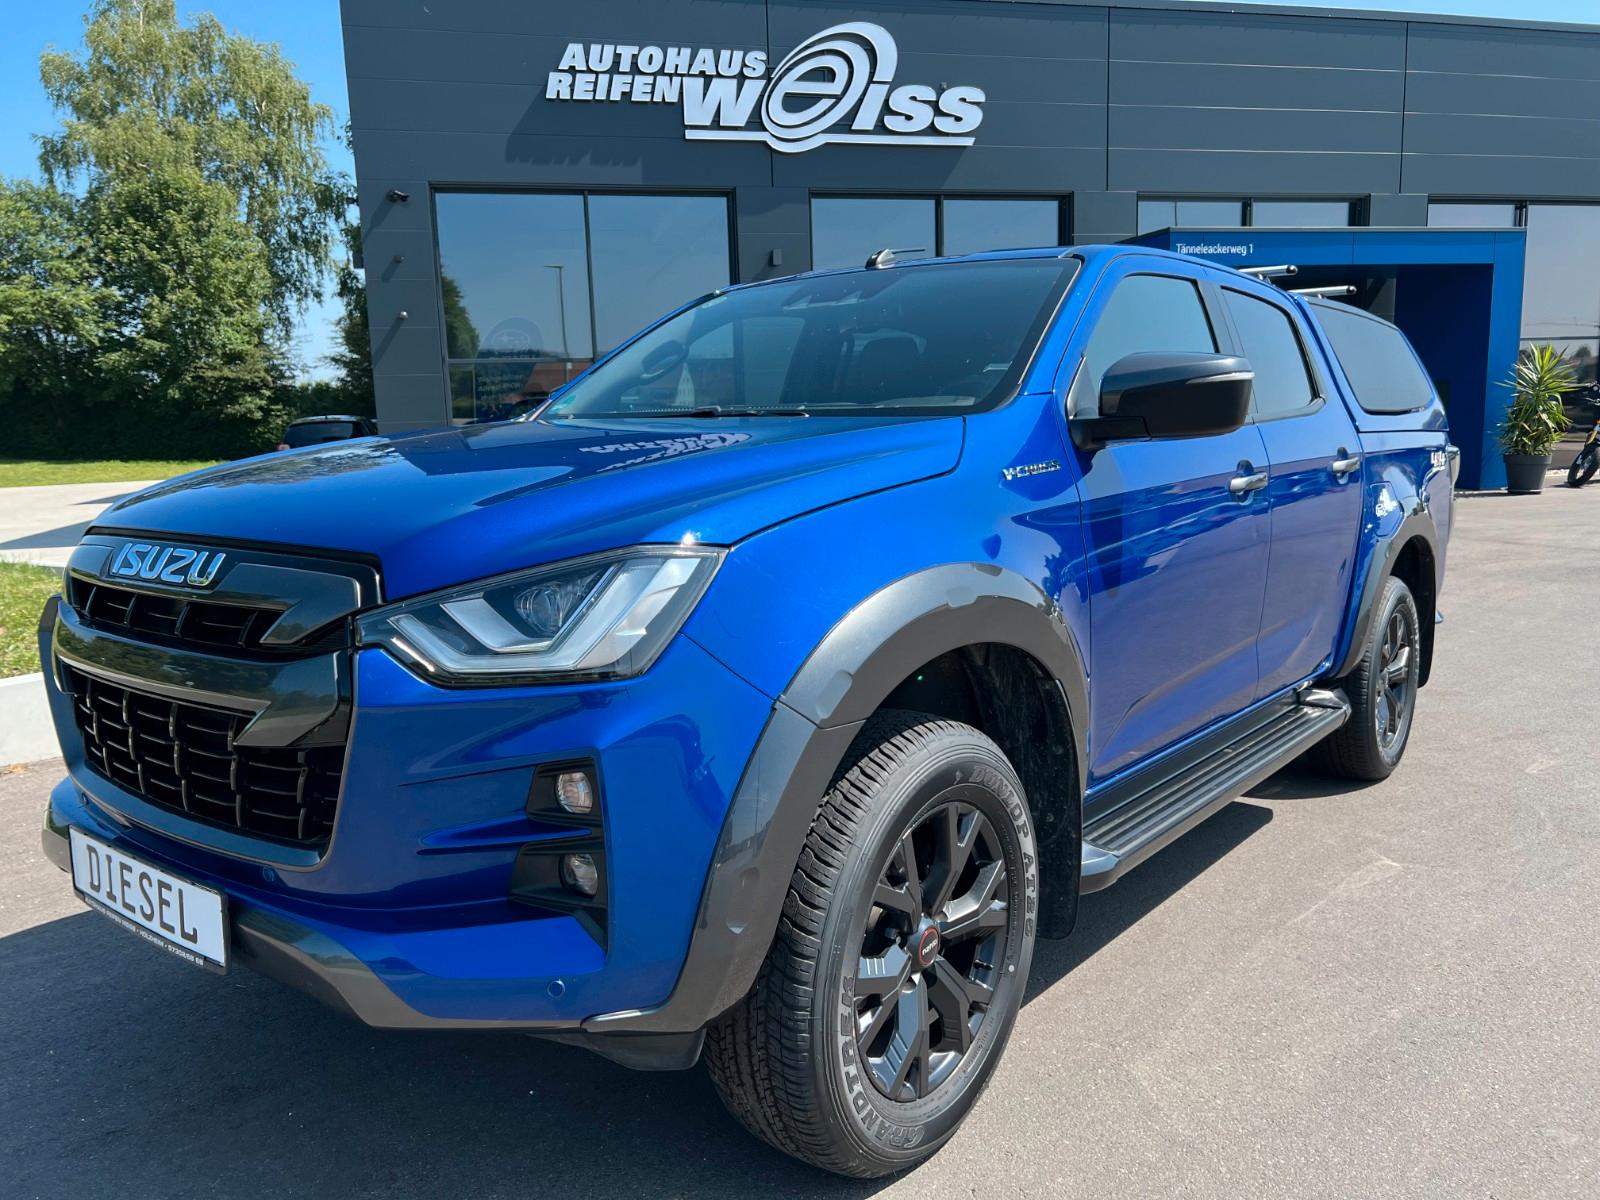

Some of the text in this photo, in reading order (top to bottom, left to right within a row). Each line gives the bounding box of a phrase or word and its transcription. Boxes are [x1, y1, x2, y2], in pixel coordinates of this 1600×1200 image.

[557, 42, 768, 78] AUTOHAUS
[545, 71, 683, 104] REIFEN
[1175, 243, 1254, 256] Tänneleackerweg 1
[111, 542, 227, 587] ISUZU
[968, 765, 1030, 840] DUNLOP
[86, 843, 198, 945] DIESEL
[840, 974, 926, 1150] GRANDTREK
